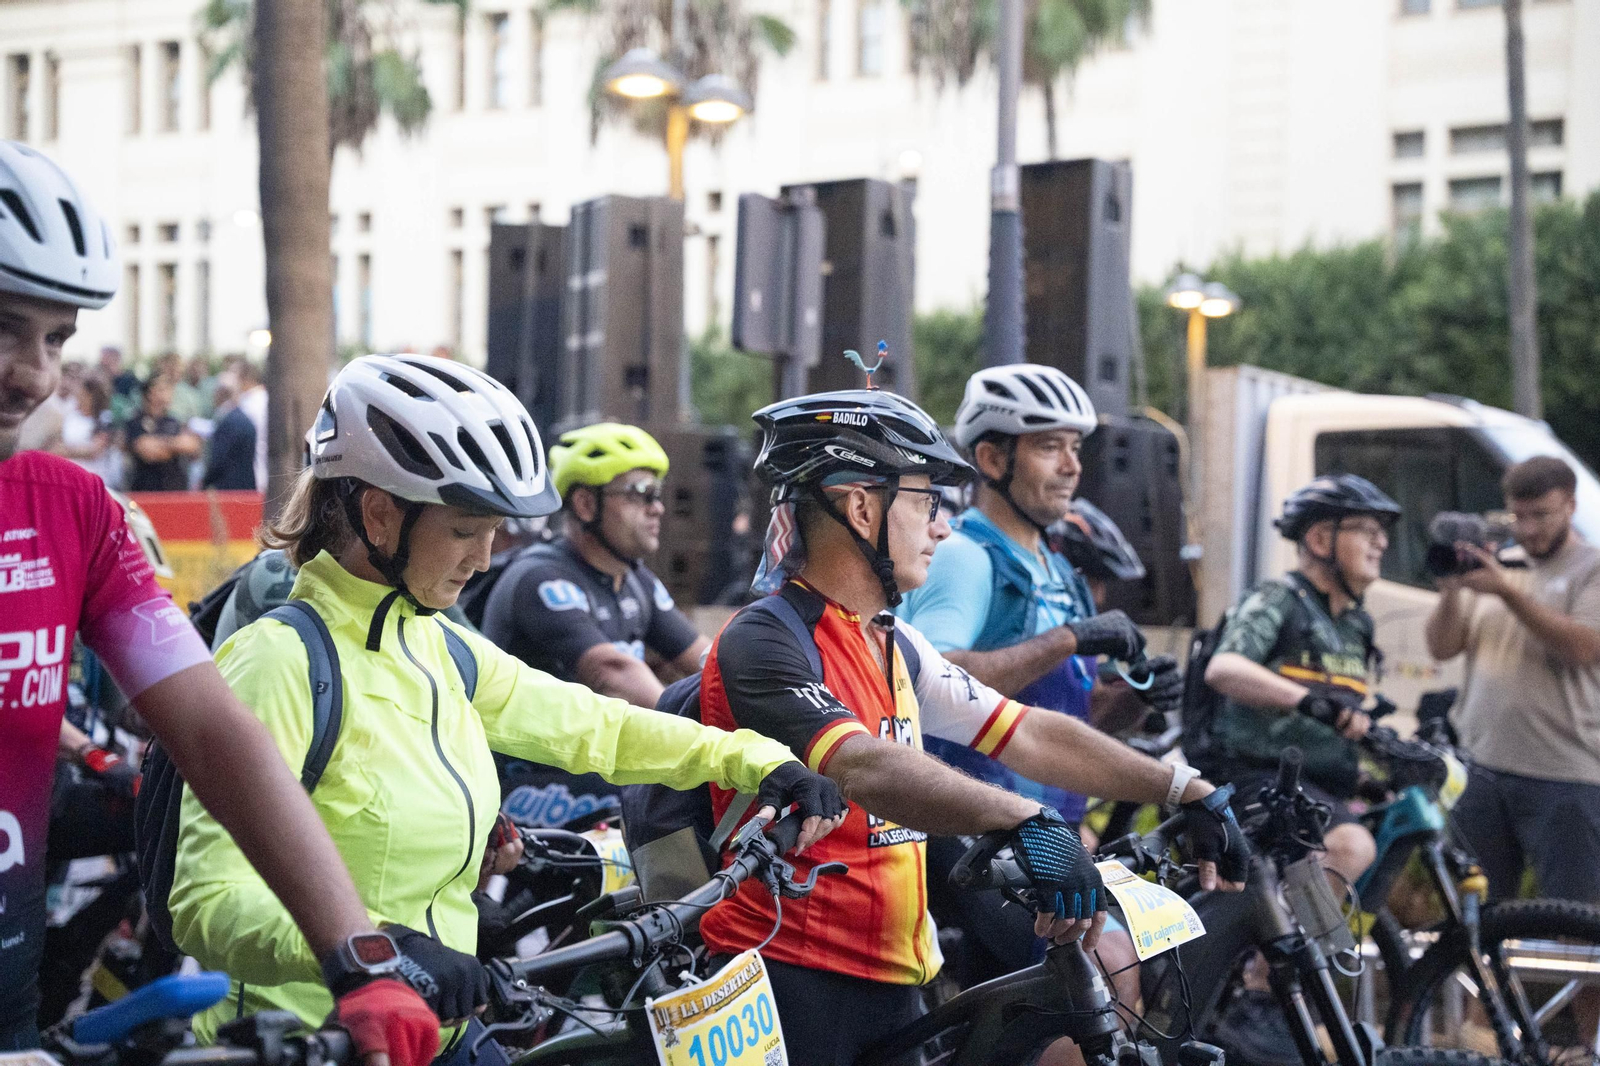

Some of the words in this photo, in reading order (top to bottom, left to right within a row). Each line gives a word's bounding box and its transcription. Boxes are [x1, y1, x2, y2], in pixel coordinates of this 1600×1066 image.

[833, 411, 868, 427] BADILLO
[870, 832, 888, 846] LA
[1153, 921, 1185, 942] cajamar
[680, 1000, 700, 1018] LA
[702, 963, 760, 1010] DESÉRTICA
[688, 992, 774, 1066] 10030
[764, 1036, 780, 1052] LUCIA
